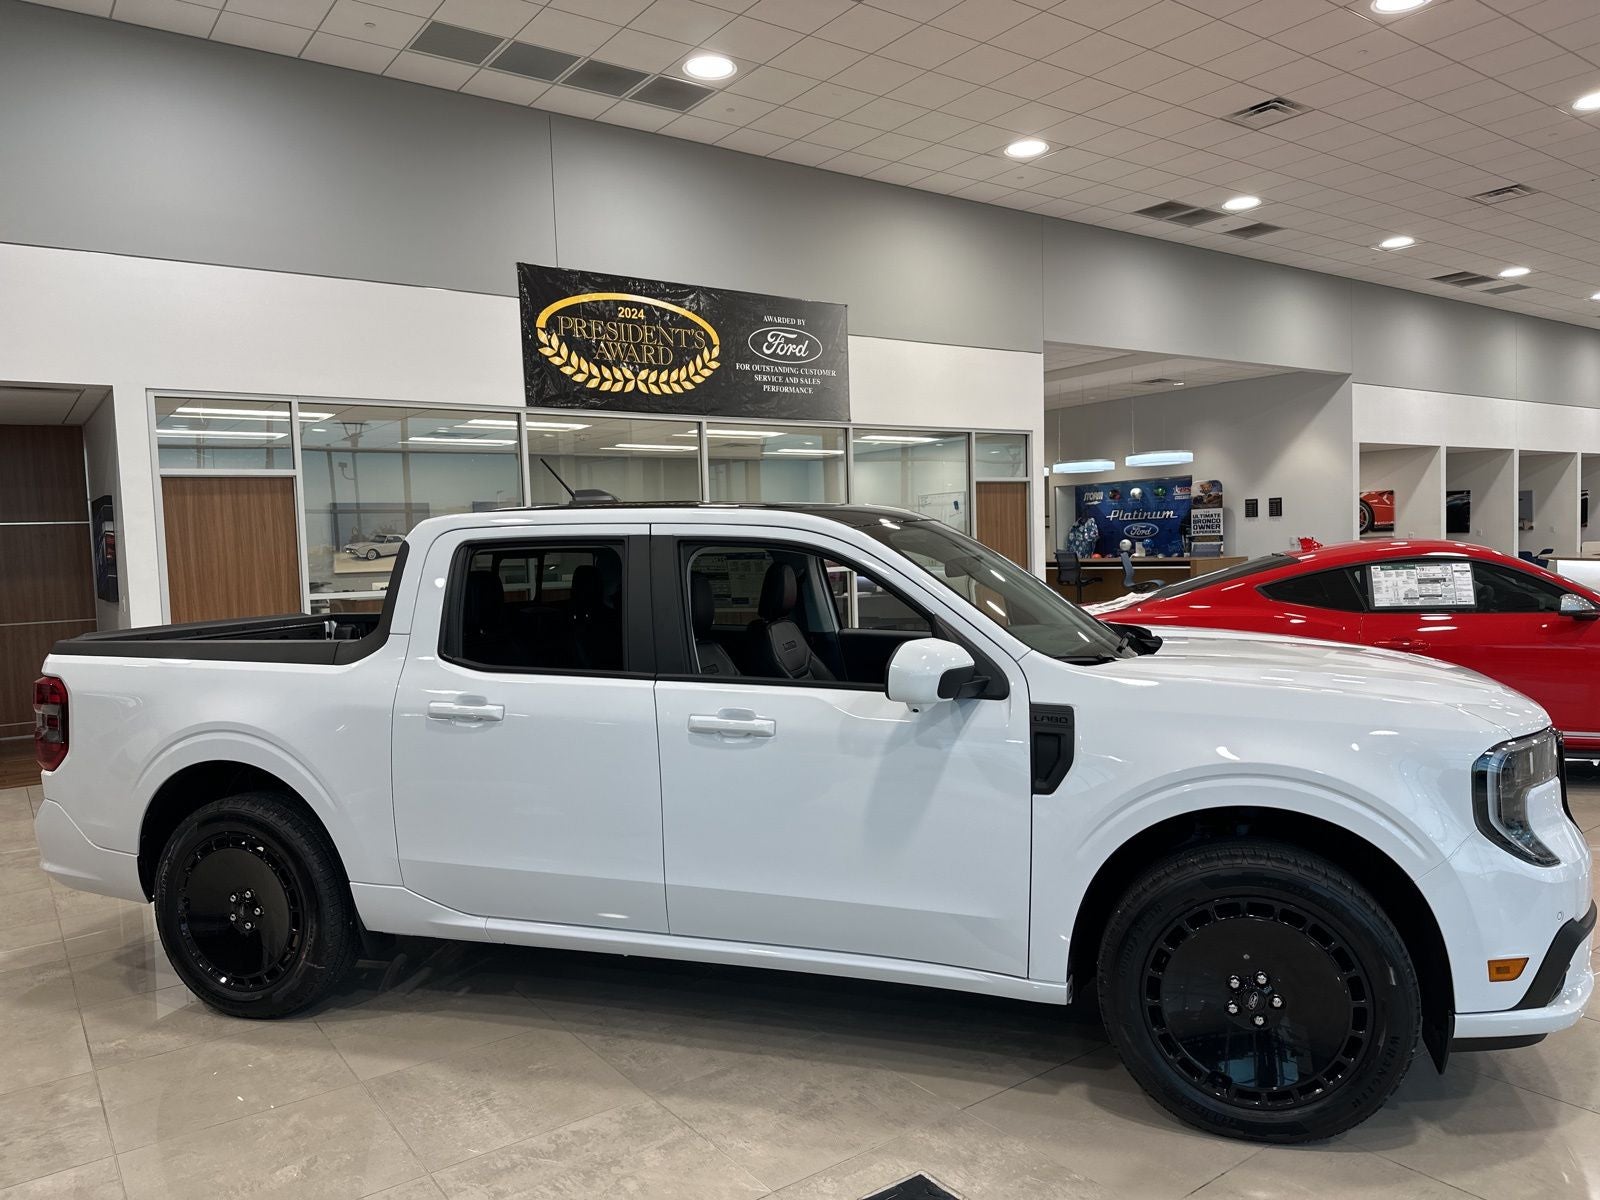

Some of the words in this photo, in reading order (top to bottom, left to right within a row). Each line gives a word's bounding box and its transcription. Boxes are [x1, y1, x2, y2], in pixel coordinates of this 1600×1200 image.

[617, 306, 645, 320] 2024
[763, 315, 796, 325] AWARDED
[556, 315, 706, 350] PRESIDENT'S
[762, 331, 809, 357] Ford
[594, 341, 673, 366] AWARD
[735, 362, 751, 371] FOR
[752, 364, 799, 374] OUTSTANDING
[800, 368, 837, 377] CUSTOMER
[754, 374, 783, 383] SERVICE
[1106, 508, 1179, 521] Platinum
[1130, 525, 1151, 536] Ford
